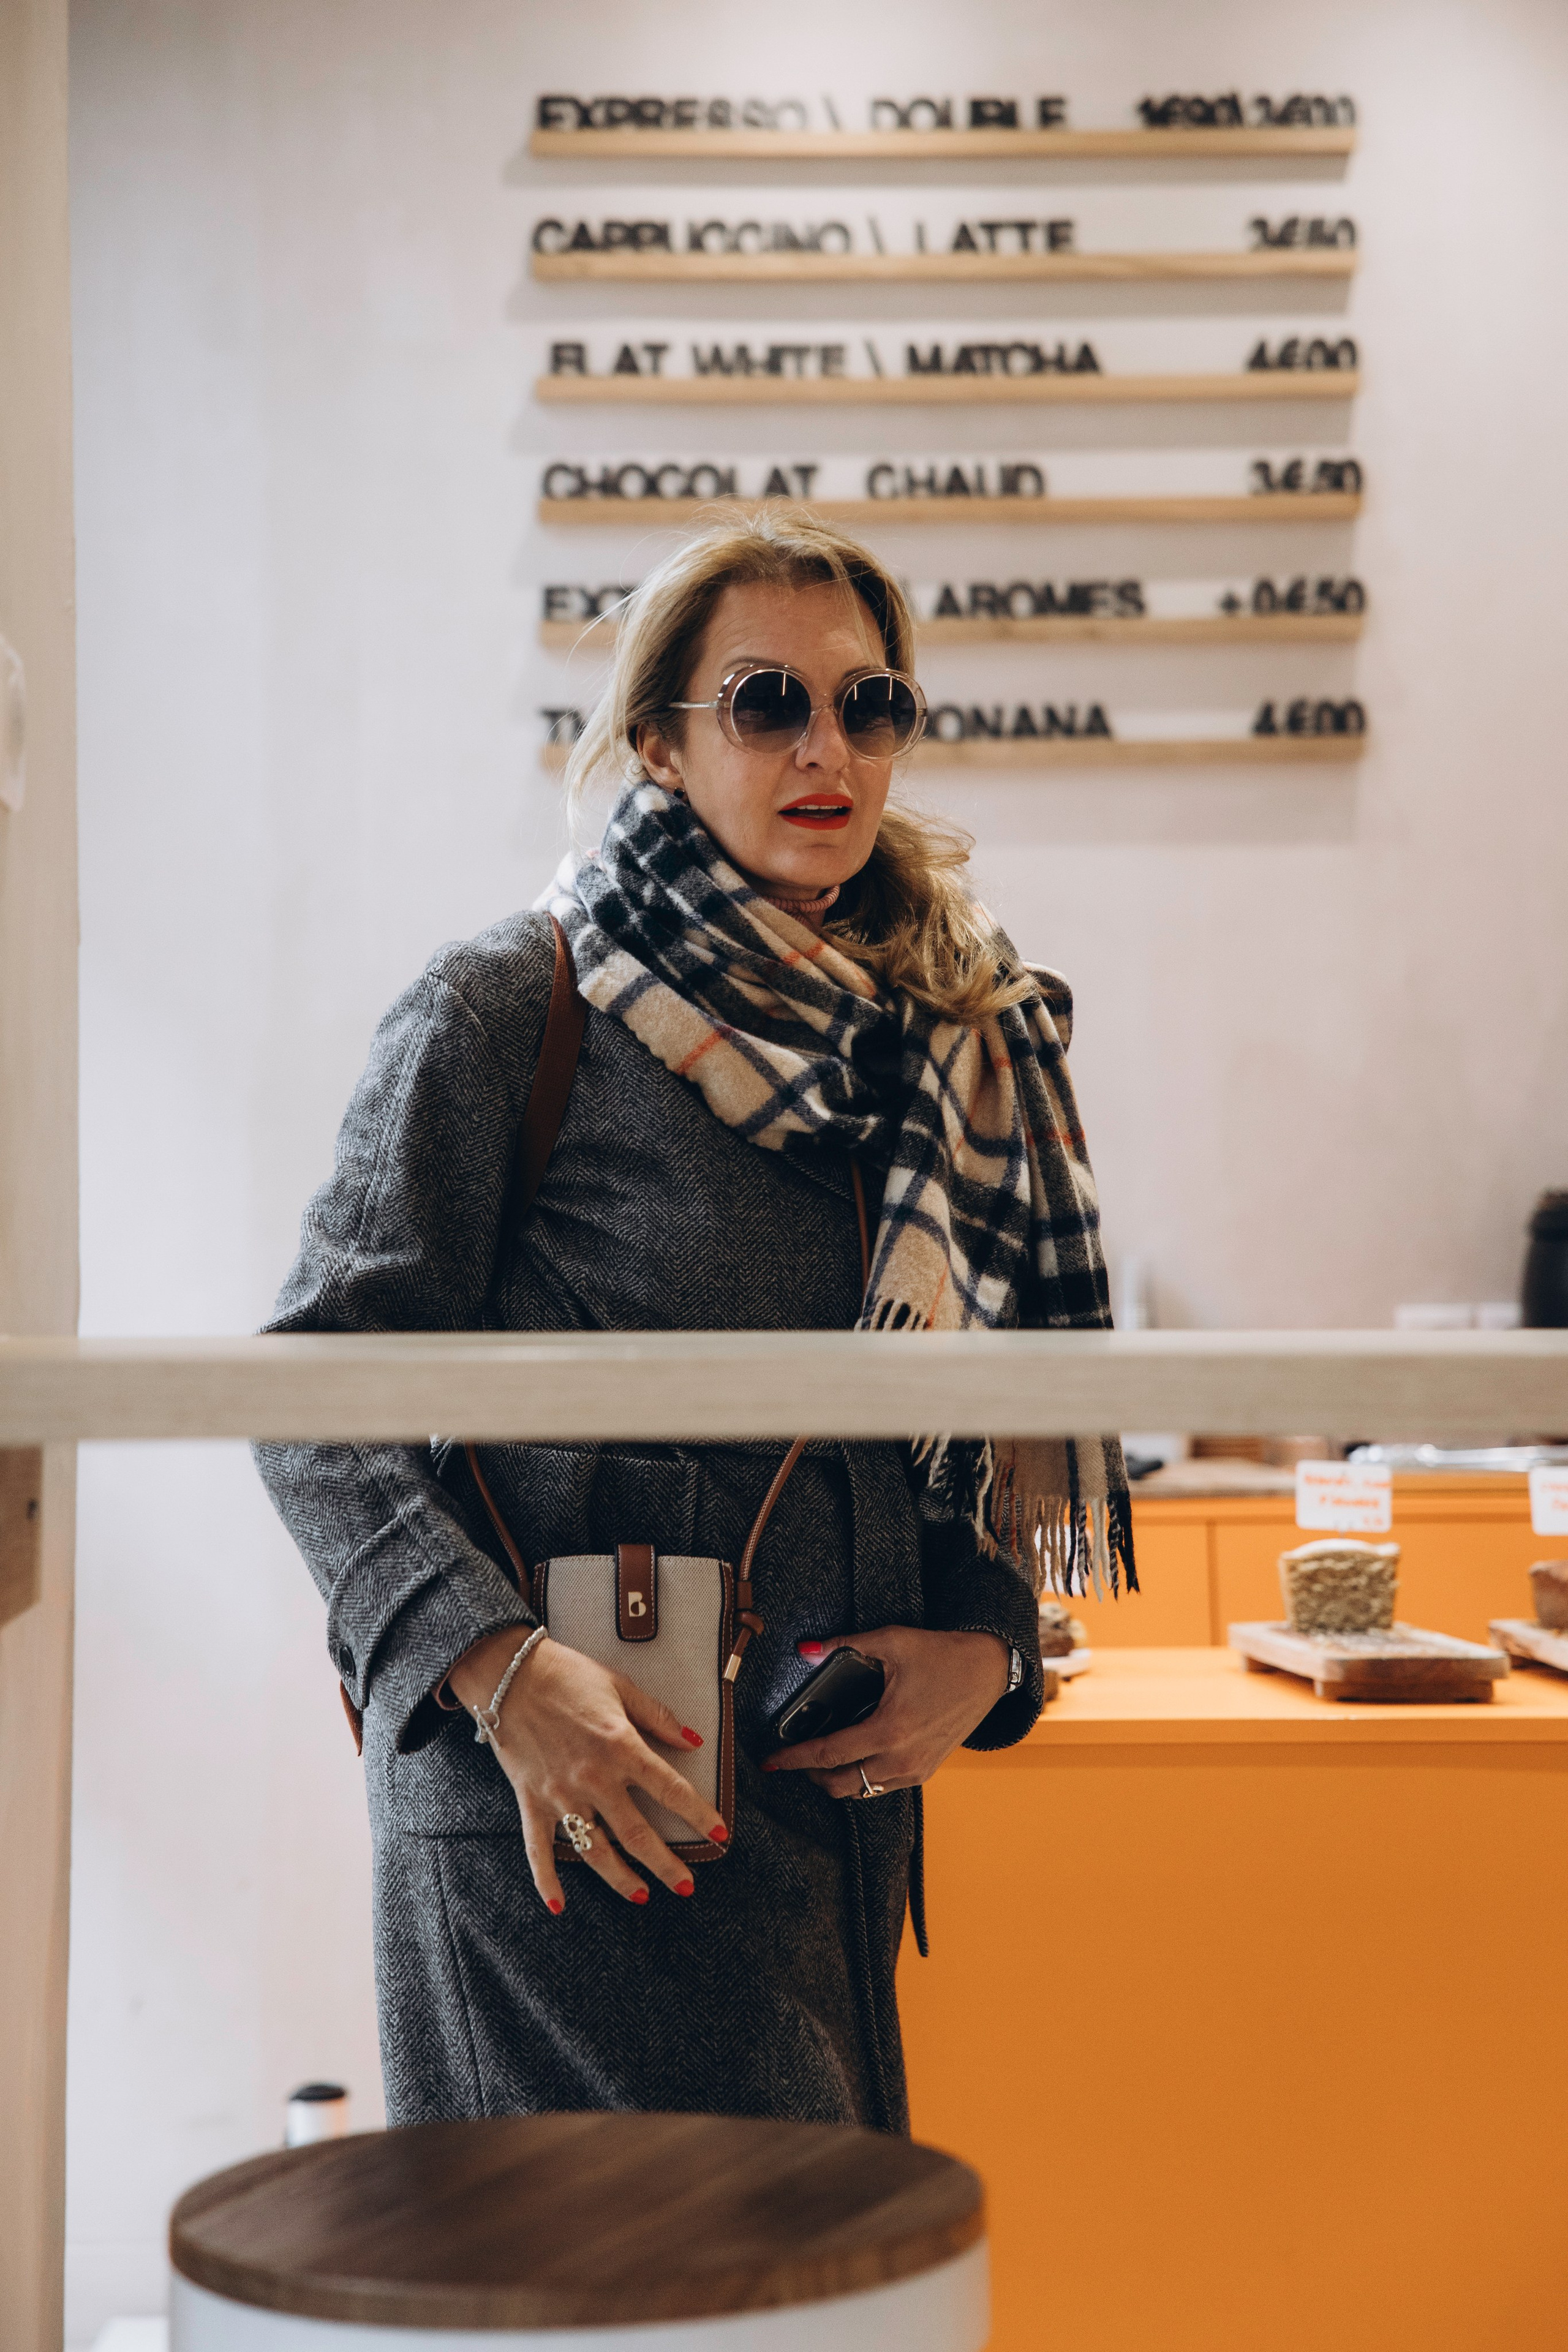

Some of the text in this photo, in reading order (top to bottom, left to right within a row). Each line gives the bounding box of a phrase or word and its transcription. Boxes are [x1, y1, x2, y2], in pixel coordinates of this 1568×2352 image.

[532, 219, 853, 255] CAPPUCCINO
[691, 341, 847, 376] WHITE
[905, 341, 1102, 375] MATCHA
[541, 463, 818, 500] CHOCOLAT
[865, 462, 1045, 499] CHAUD
[933, 579, 1144, 618] AROMES
